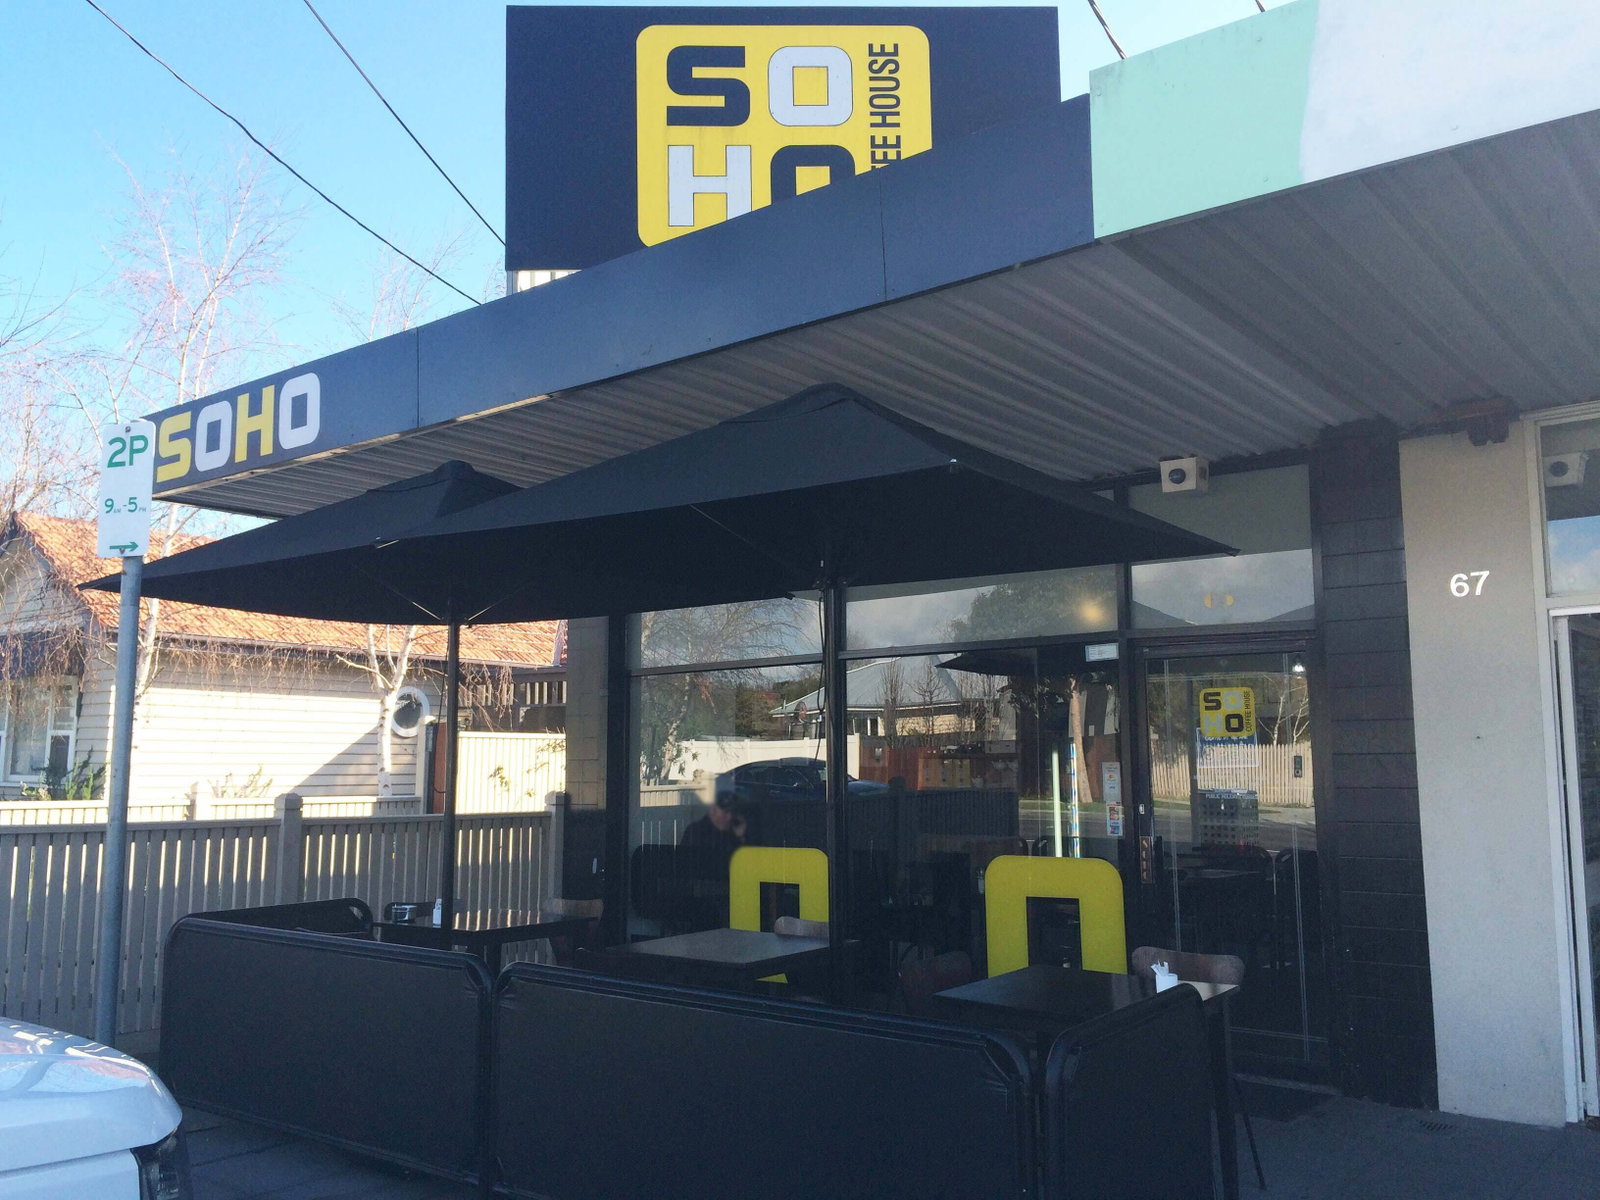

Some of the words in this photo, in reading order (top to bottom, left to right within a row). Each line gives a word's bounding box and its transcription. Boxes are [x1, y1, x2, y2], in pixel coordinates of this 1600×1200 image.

[868, 43, 901, 128] HOUSE
[107, 434, 149, 468] 2P
[156, 372, 321, 483] SOHO
[1450, 570, 1490, 598] 67
